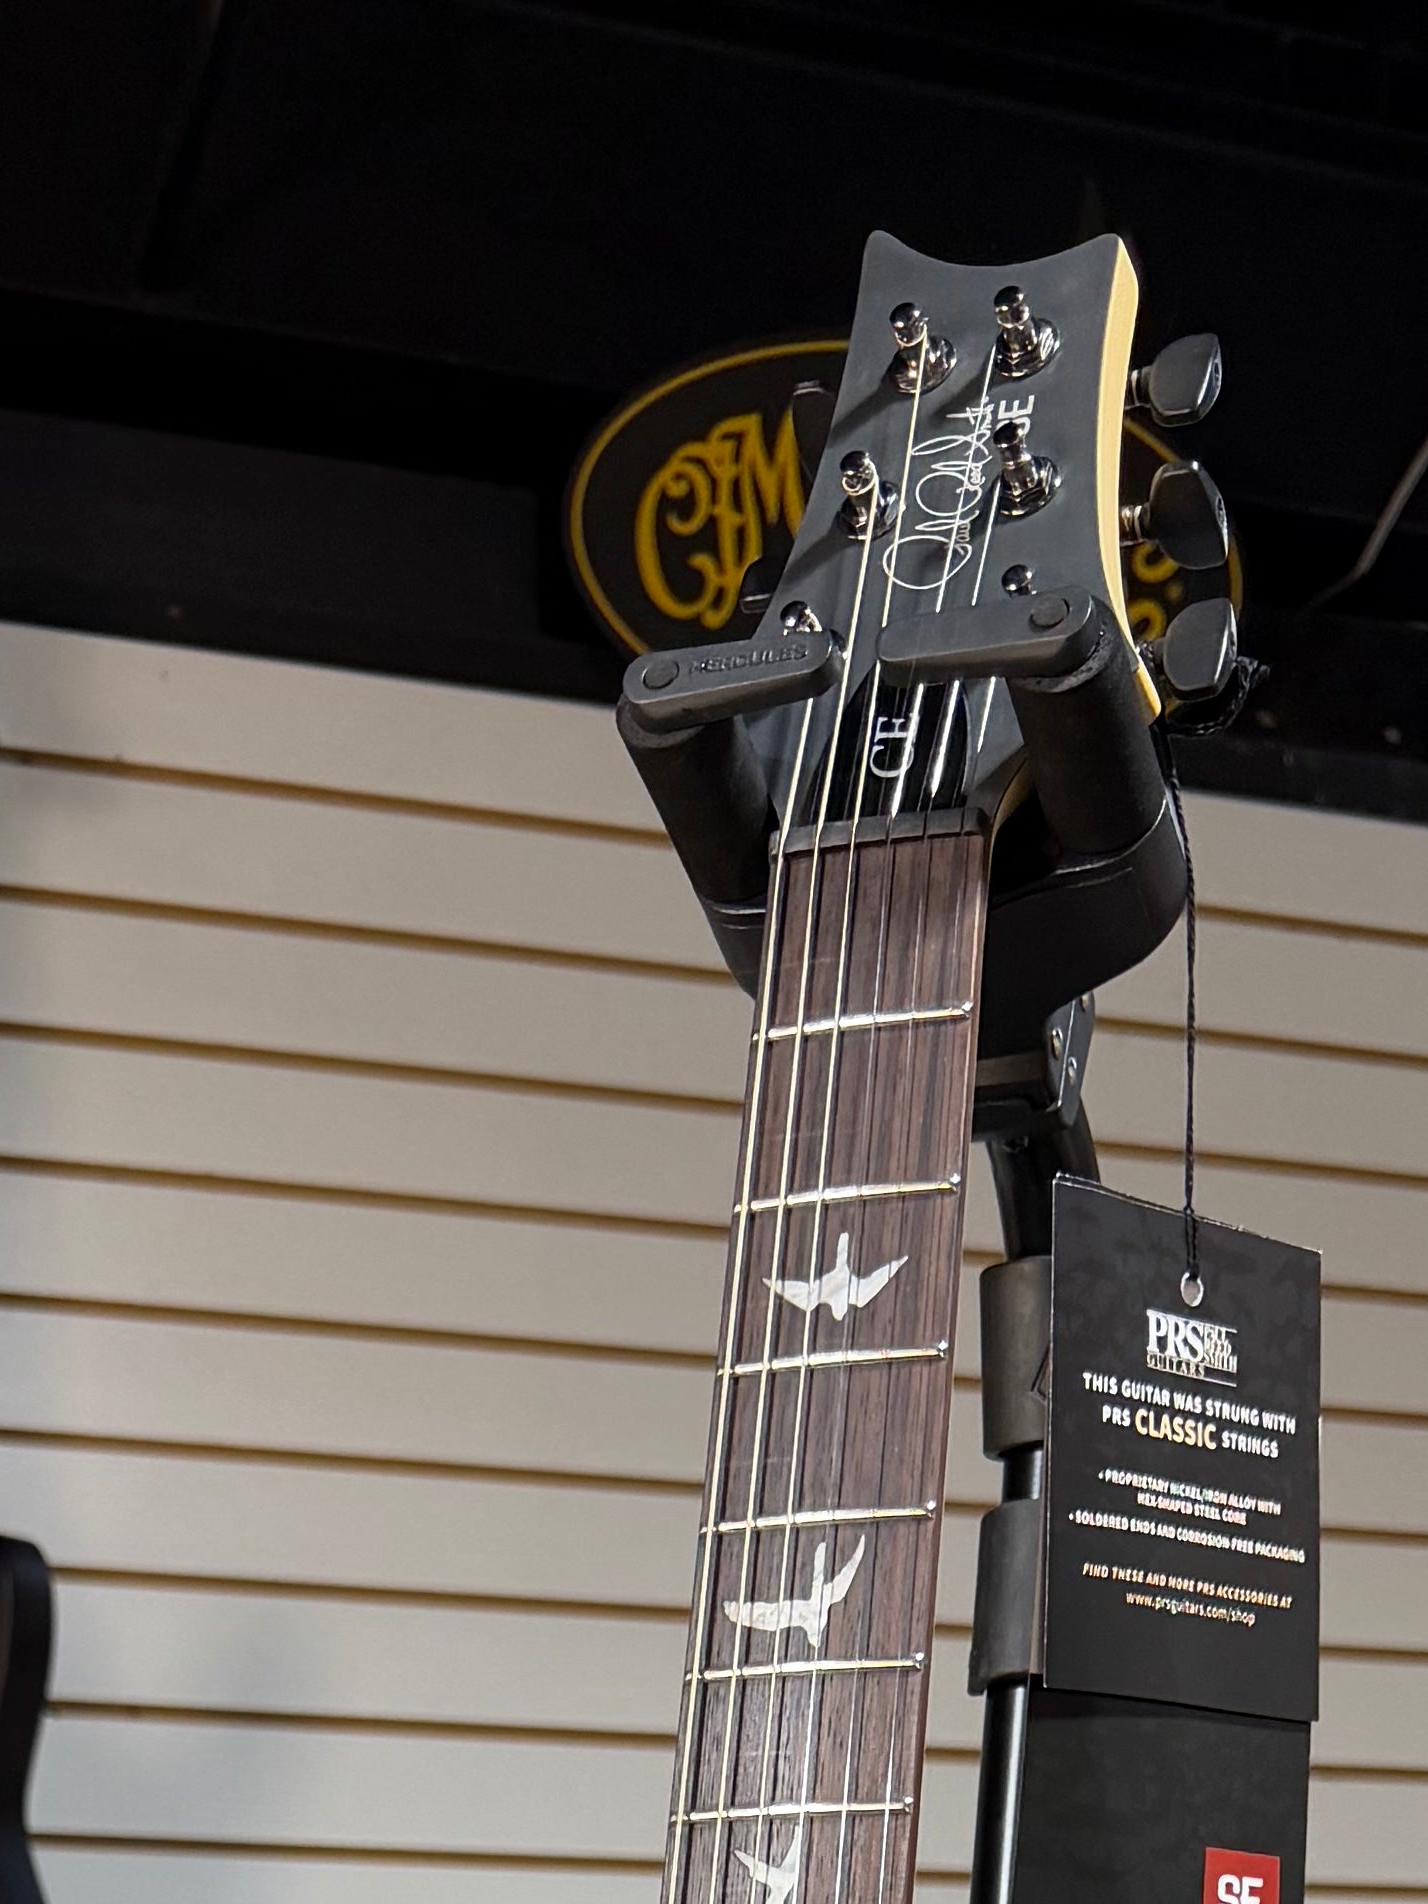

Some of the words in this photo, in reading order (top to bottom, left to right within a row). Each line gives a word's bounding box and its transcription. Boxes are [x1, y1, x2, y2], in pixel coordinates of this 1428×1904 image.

[869, 713, 920, 778] CE
[1146, 1309, 1204, 1362] PRS
[1146, 1352, 1206, 1379] GUITARS
[1082, 1372, 1118, 1395] THIS
[1121, 1379, 1171, 1407] GUITAR
[1173, 1391, 1202, 1414] WAS
[1205, 1398, 1259, 1427] STRUNG
[1262, 1411, 1297, 1435] WITH
[1102, 1405, 1131, 1427] PRS
[1134, 1408, 1217, 1450] CLASSIC
[1221, 1430, 1279, 1459] STRINGS
[1075, 1510, 1129, 1532] SOLDERED
[1082, 1562, 1109, 1580] FIND
[1112, 1566, 1144, 1584] THESE
[1145, 1572, 1167, 1588] AND
[1167, 1575, 1194, 1593] MORE
[1196, 1580, 1215, 1597] PRS
[1216, 1585, 1279, 1608] ACCESSORIES
[1279, 1596, 1293, 1610] AT
[1125, 1592, 1257, 1628] www.prsguitars.com/shop
